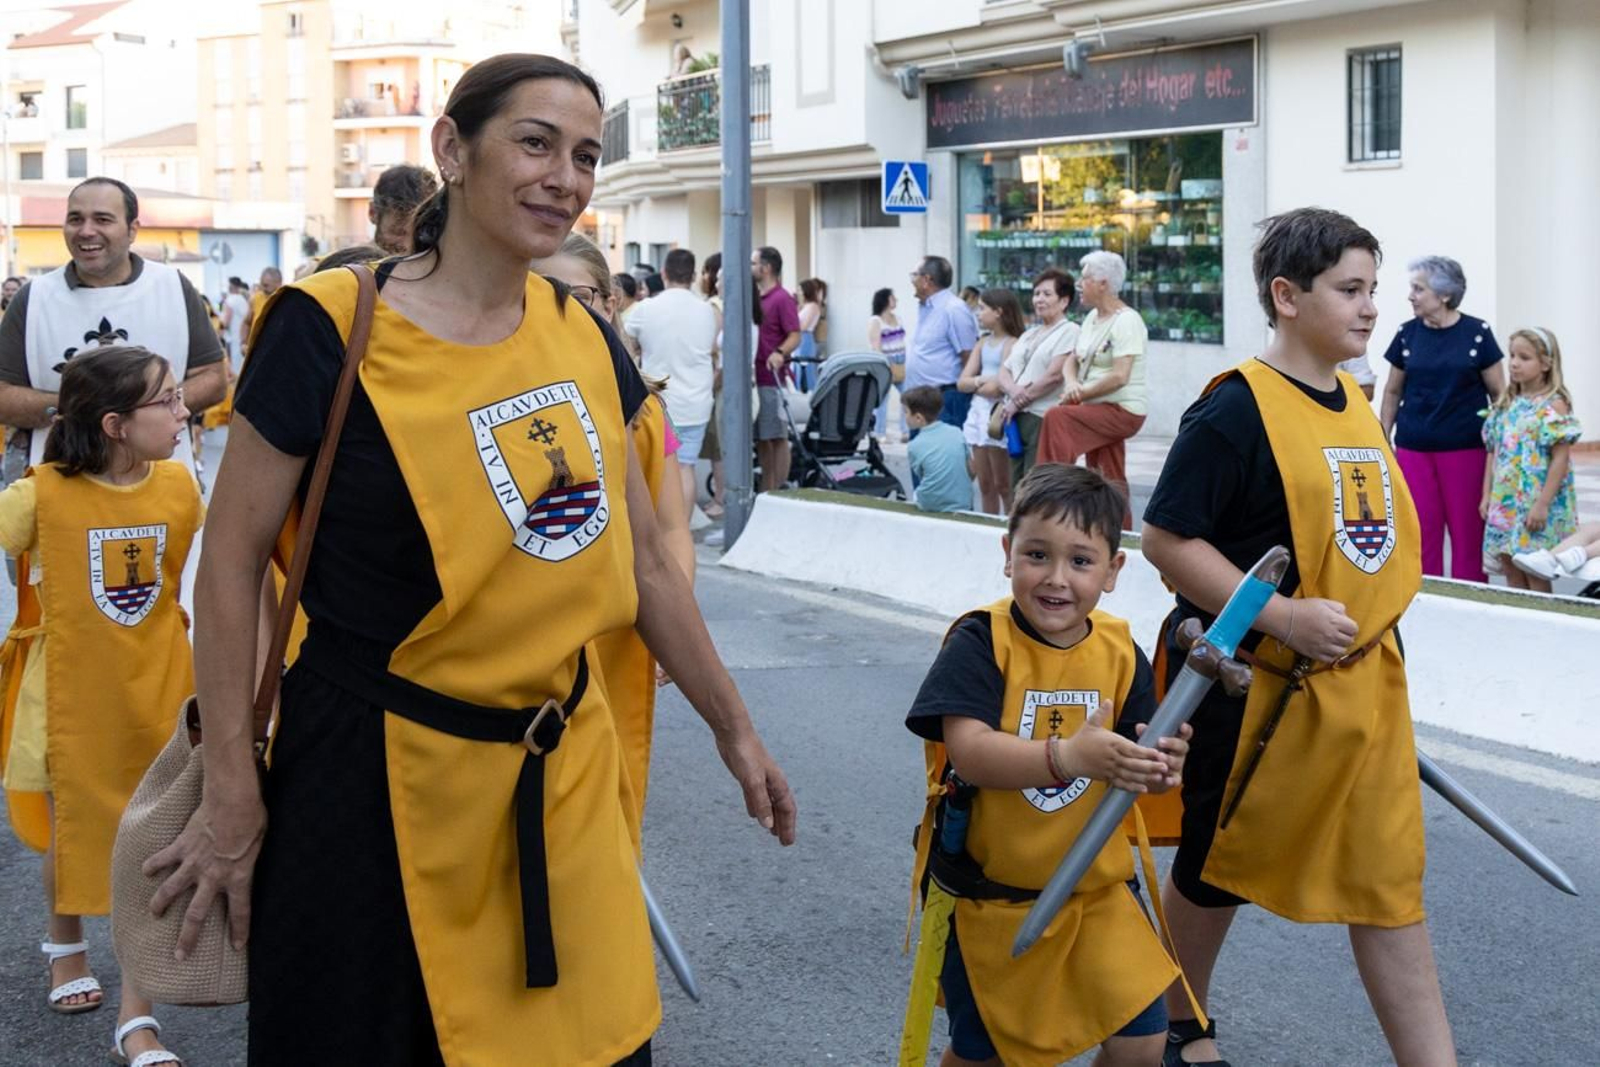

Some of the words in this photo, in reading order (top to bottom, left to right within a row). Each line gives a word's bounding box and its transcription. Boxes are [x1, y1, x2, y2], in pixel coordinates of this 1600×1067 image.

[1119, 68, 1142, 107] del
[1146, 66, 1196, 111] Hogar
[1205, 61, 1246, 99] etc...
[477, 384, 578, 430] ALCAVDETE
[480, 441, 503, 468] TV
[496, 480, 519, 505] IN
[523, 534, 551, 555] ET
[572, 506, 608, 547] EGO
[1059, 778, 1087, 805] EGO
